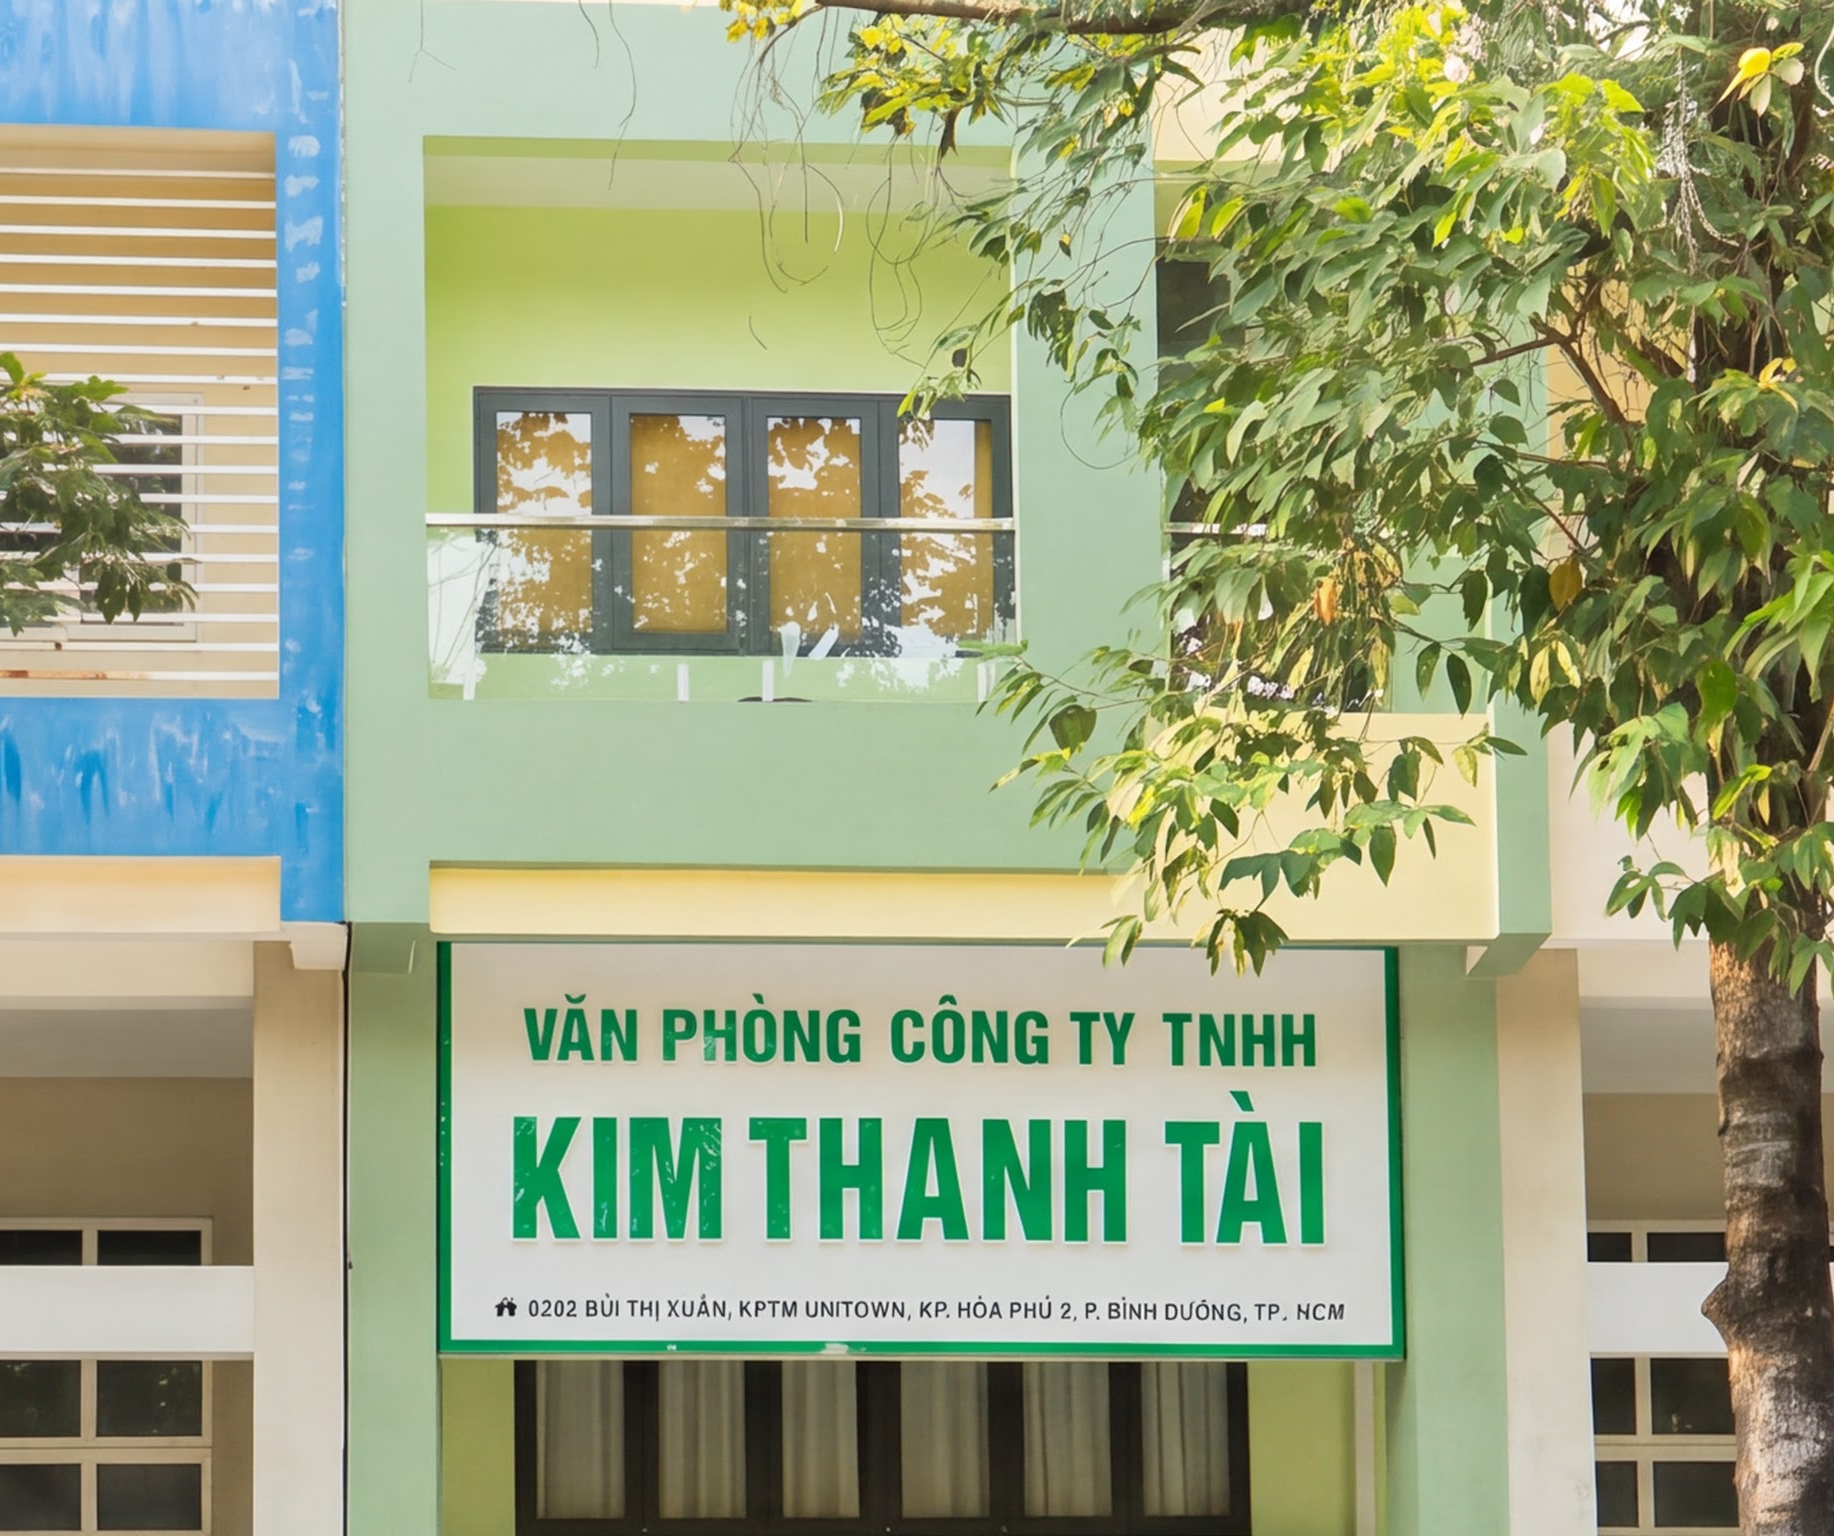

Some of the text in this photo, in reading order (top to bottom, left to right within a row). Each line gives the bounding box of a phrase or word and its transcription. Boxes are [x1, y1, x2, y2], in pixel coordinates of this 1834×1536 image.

[522, 993, 1317, 1068] VĂN PHÒNG CÔNG TY TNHH
[510, 1090, 1326, 1246] KIM THANH TÀI
[528, 1299, 578, 1318] 0202
[739, 1300, 798, 1318] KPTM
[805, 1300, 912, 1322] UNITOWN,
[919, 1301, 950, 1319] KP.
[1060, 1302, 1077, 1322] 2,
[1085, 1302, 1100, 1321] P.
